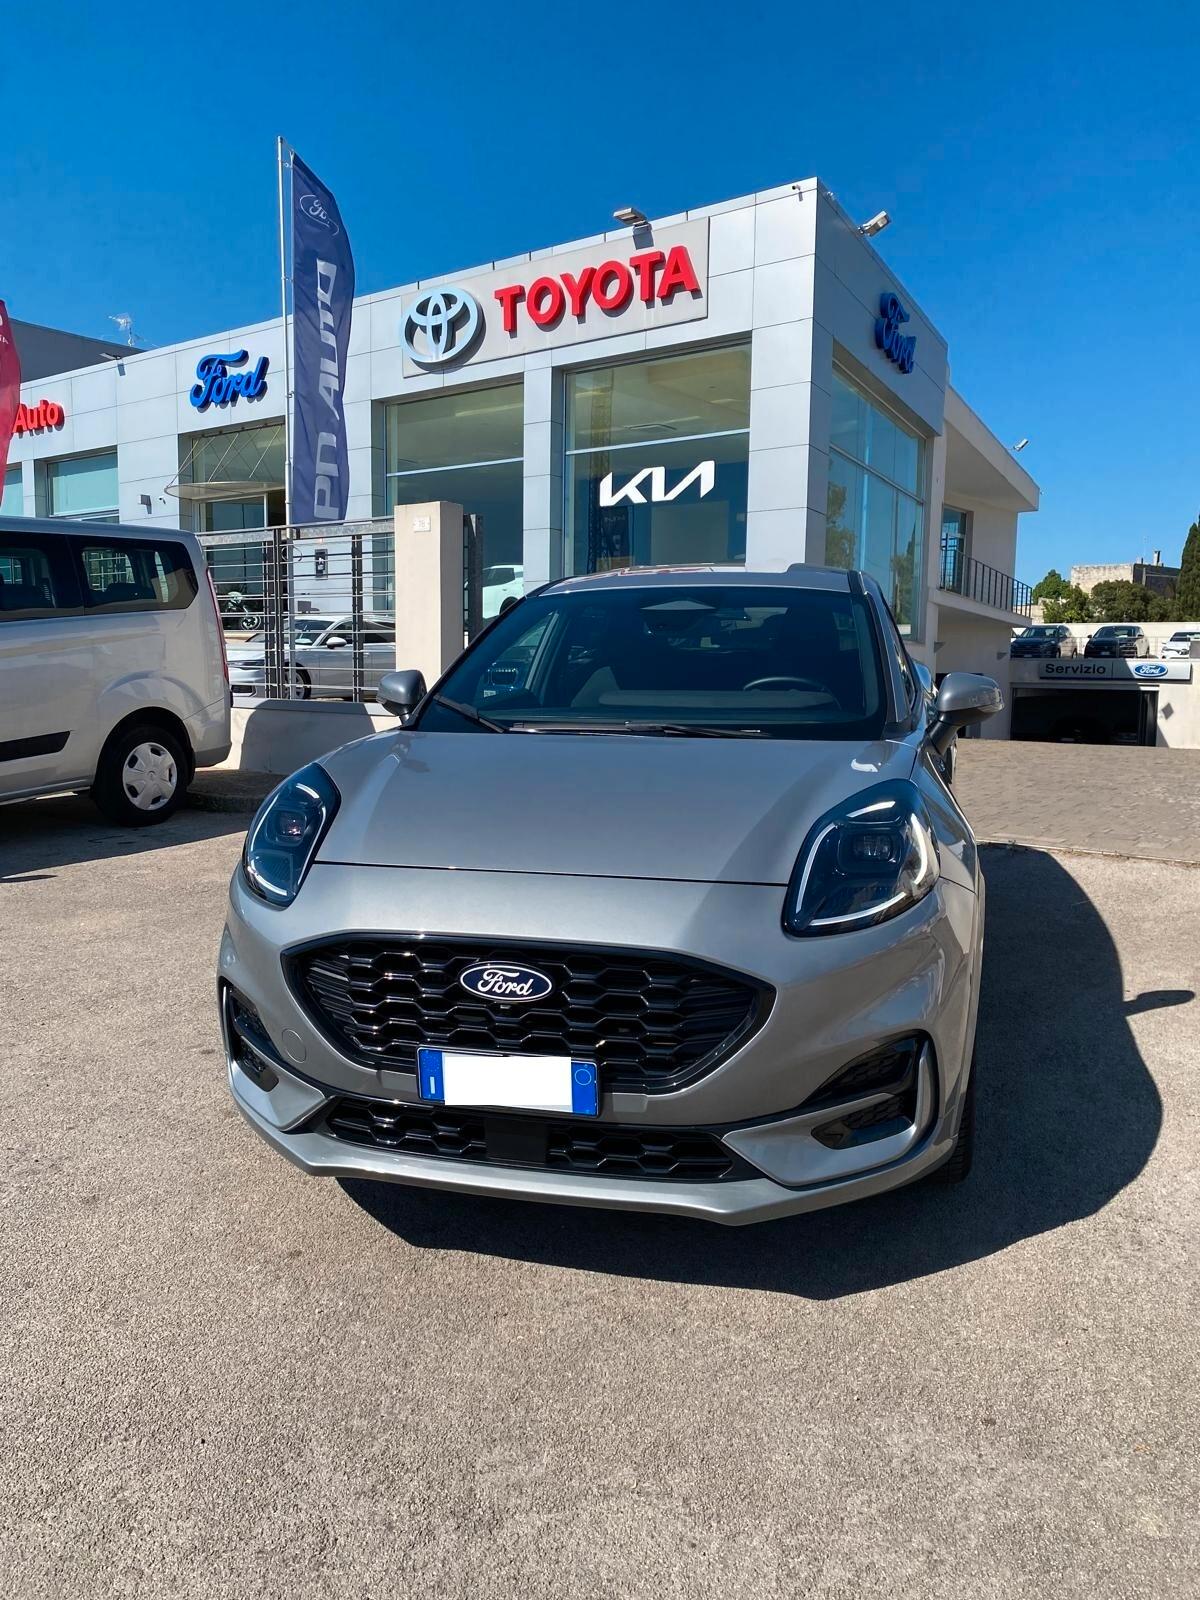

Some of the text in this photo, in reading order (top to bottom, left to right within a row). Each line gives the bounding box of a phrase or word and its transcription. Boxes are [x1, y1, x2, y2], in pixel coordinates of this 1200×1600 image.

[494, 244, 703, 333] TOYOTA
[874, 292, 917, 374] Ford
[190, 349, 270, 409] Ford
[12, 400, 65, 433] Auto
[599, 460, 716, 507] KIA
[1045, 662, 1106, 675] Servizio
[477, 968, 533, 996] Ford
